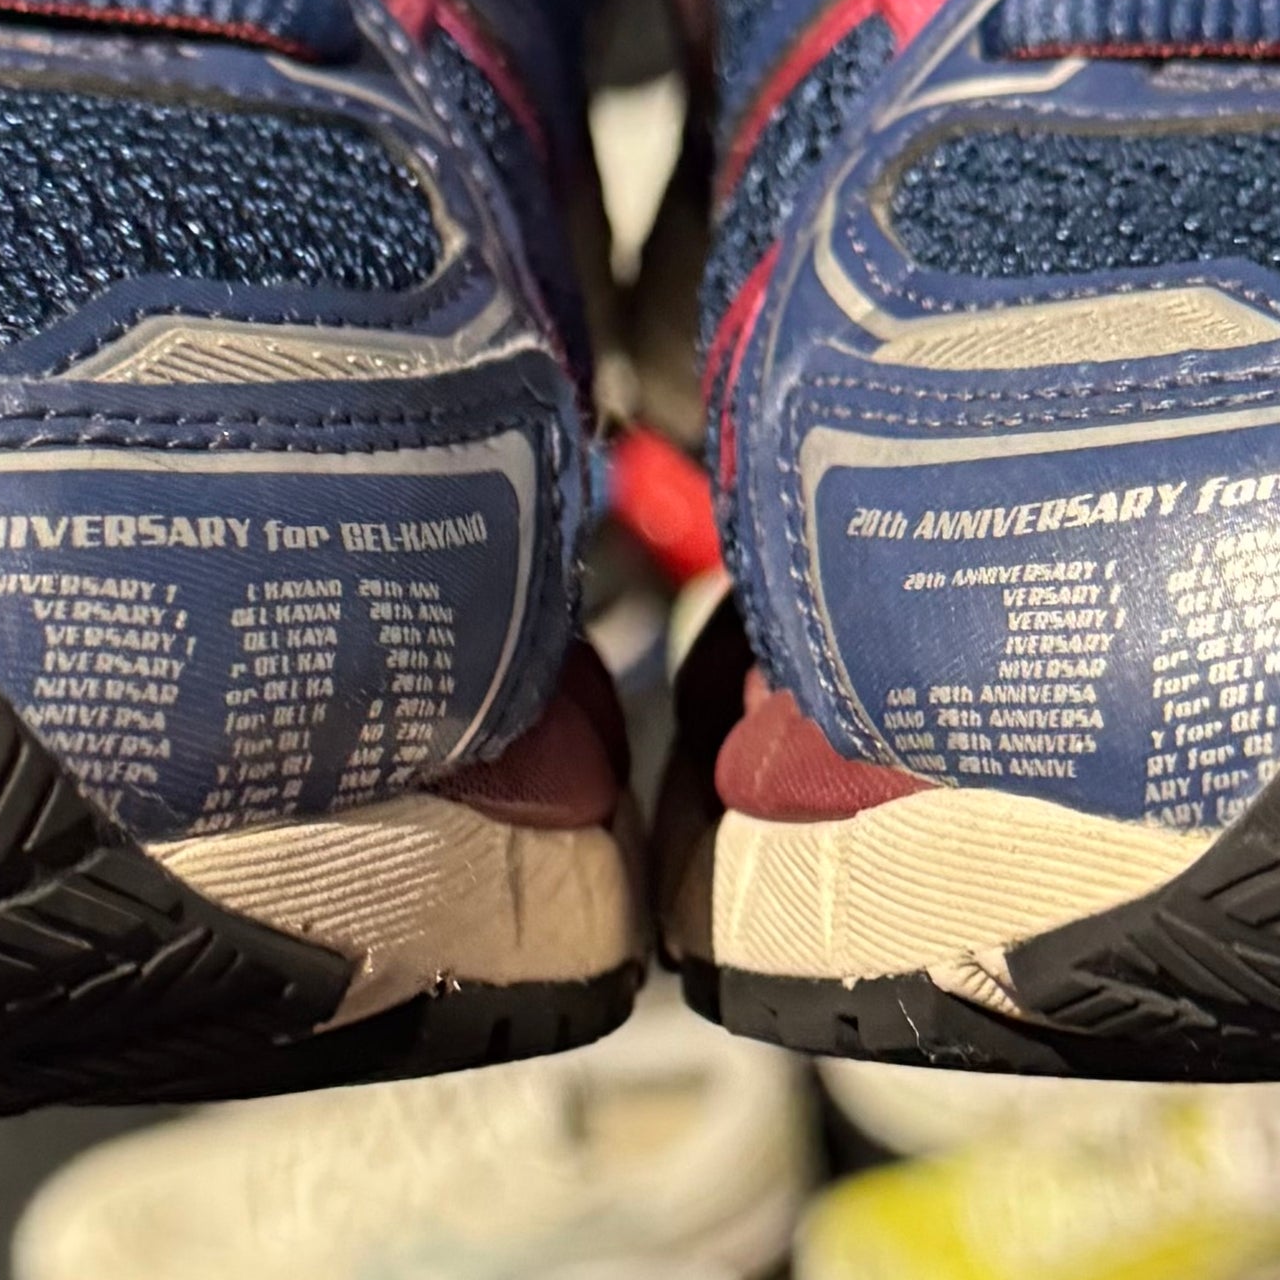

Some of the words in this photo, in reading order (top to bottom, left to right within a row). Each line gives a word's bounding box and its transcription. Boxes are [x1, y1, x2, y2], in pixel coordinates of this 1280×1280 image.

[264, 519, 331, 552] for
[339, 511, 488, 552] GEL-KAYANO
[847, 507, 907, 541] 20th
[913, 481, 1188, 541] ANNIVERSARY
